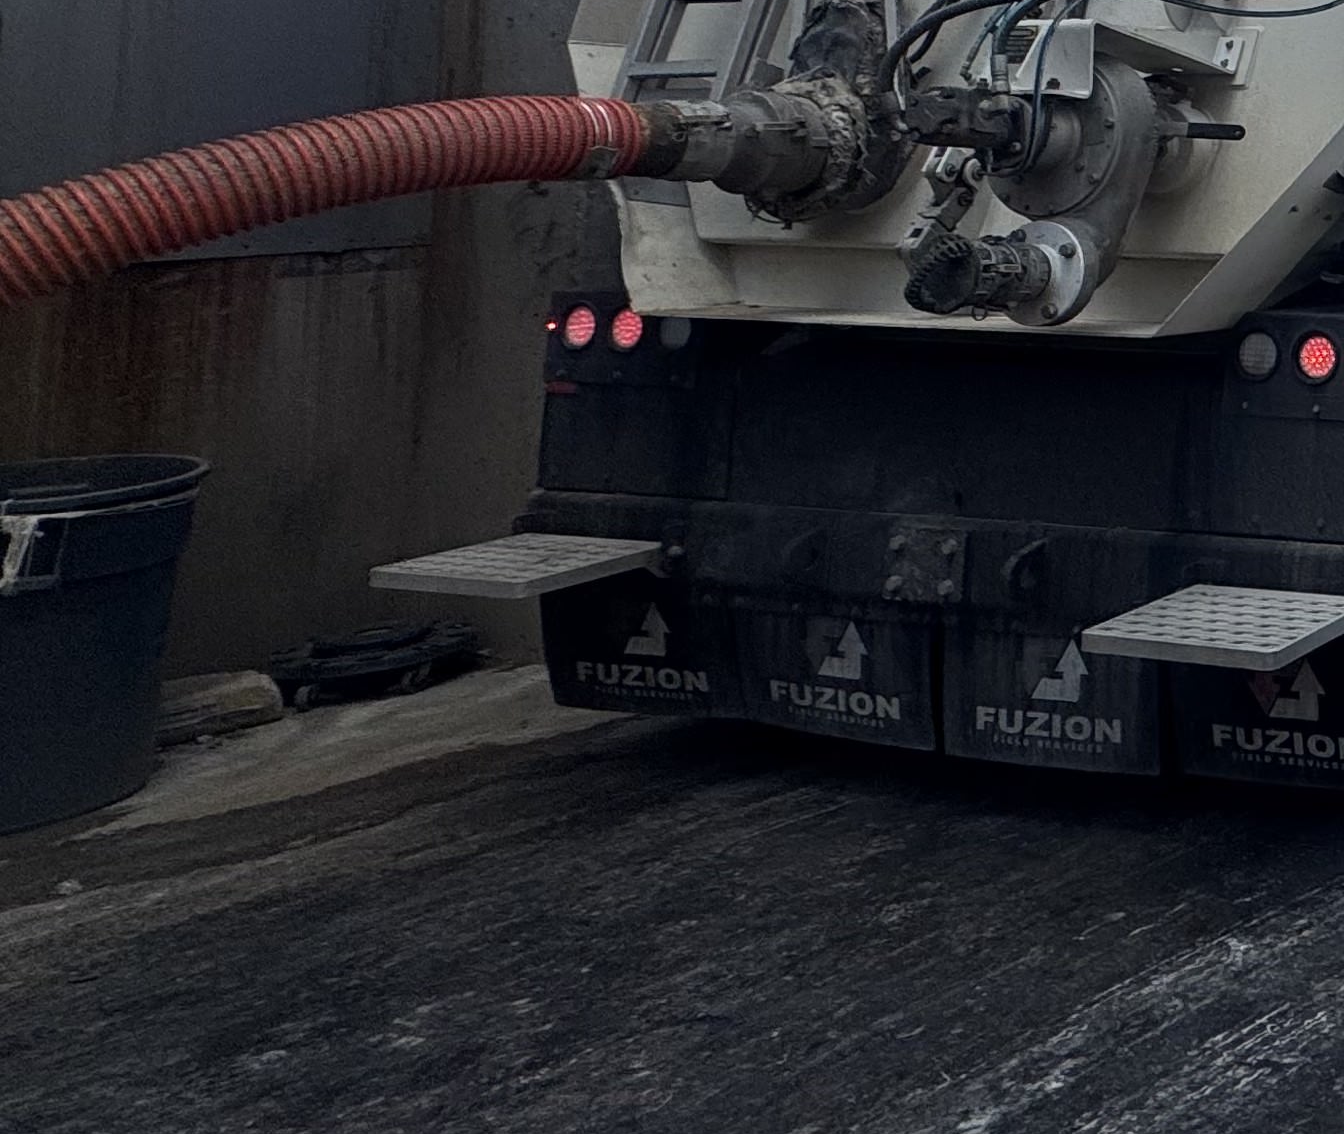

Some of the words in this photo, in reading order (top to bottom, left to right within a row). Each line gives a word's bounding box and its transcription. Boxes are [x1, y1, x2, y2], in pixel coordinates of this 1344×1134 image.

[576, 661, 709, 692] FUZION
[769, 679, 901, 720] FUZION
[975, 705, 1122, 744] FUZION
